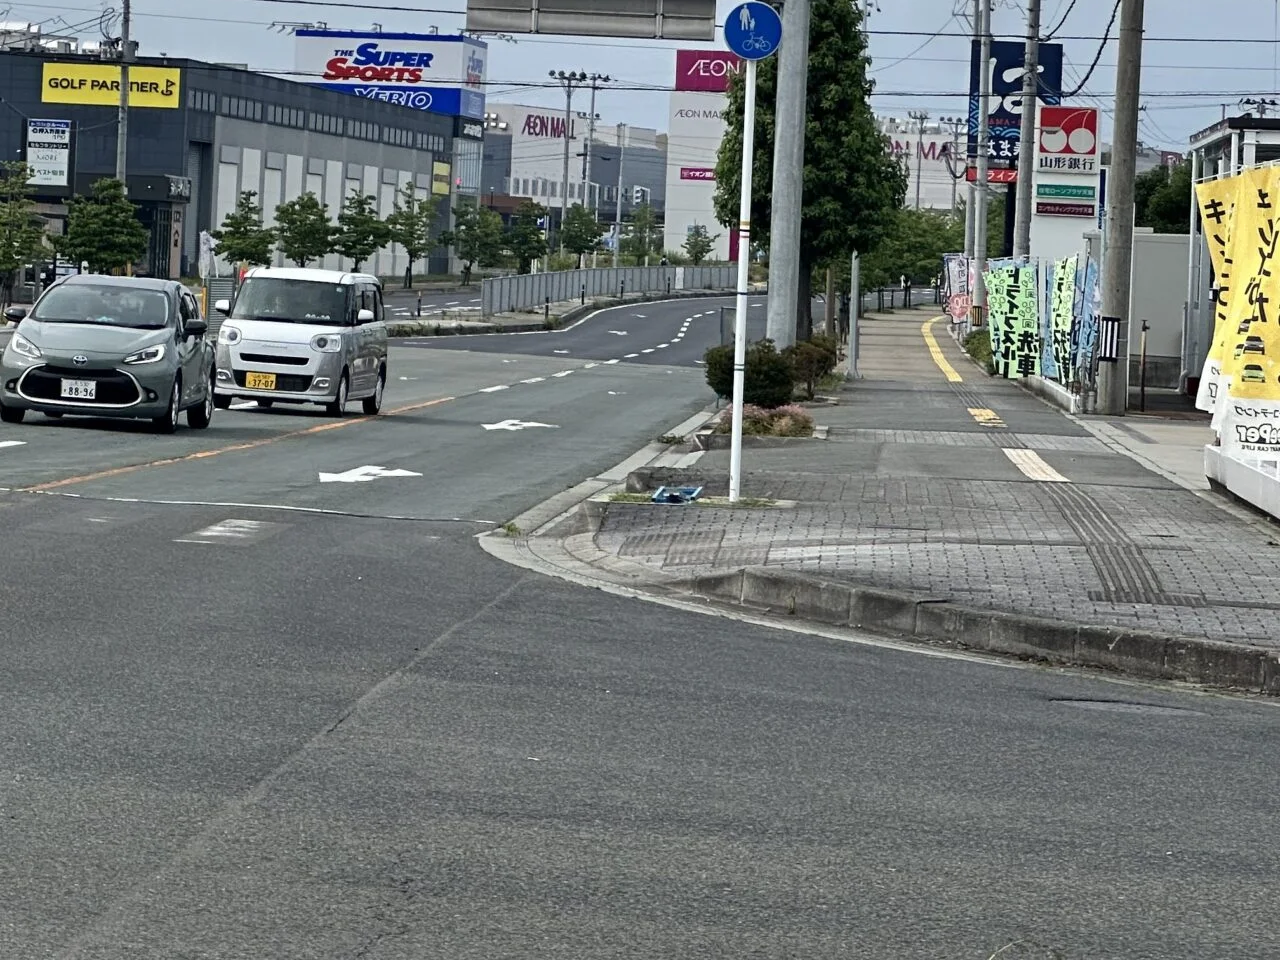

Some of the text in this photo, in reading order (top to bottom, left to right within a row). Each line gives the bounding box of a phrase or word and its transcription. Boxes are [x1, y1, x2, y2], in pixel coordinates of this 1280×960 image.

[334, 43, 434, 68] THE SUPER
[322, 57, 424, 84] SPORTS
[48, 78, 159, 93] GOLF PARNER
[702, 110, 723, 119] MA
[550, 116, 577, 140] MAL
[1039, 156, 1095, 171] 山形銀行
[987, 170, 1019, 182] ライブ
[252, 379, 274, 388] 37-07
[68, 386, 94, 398] 88-96
